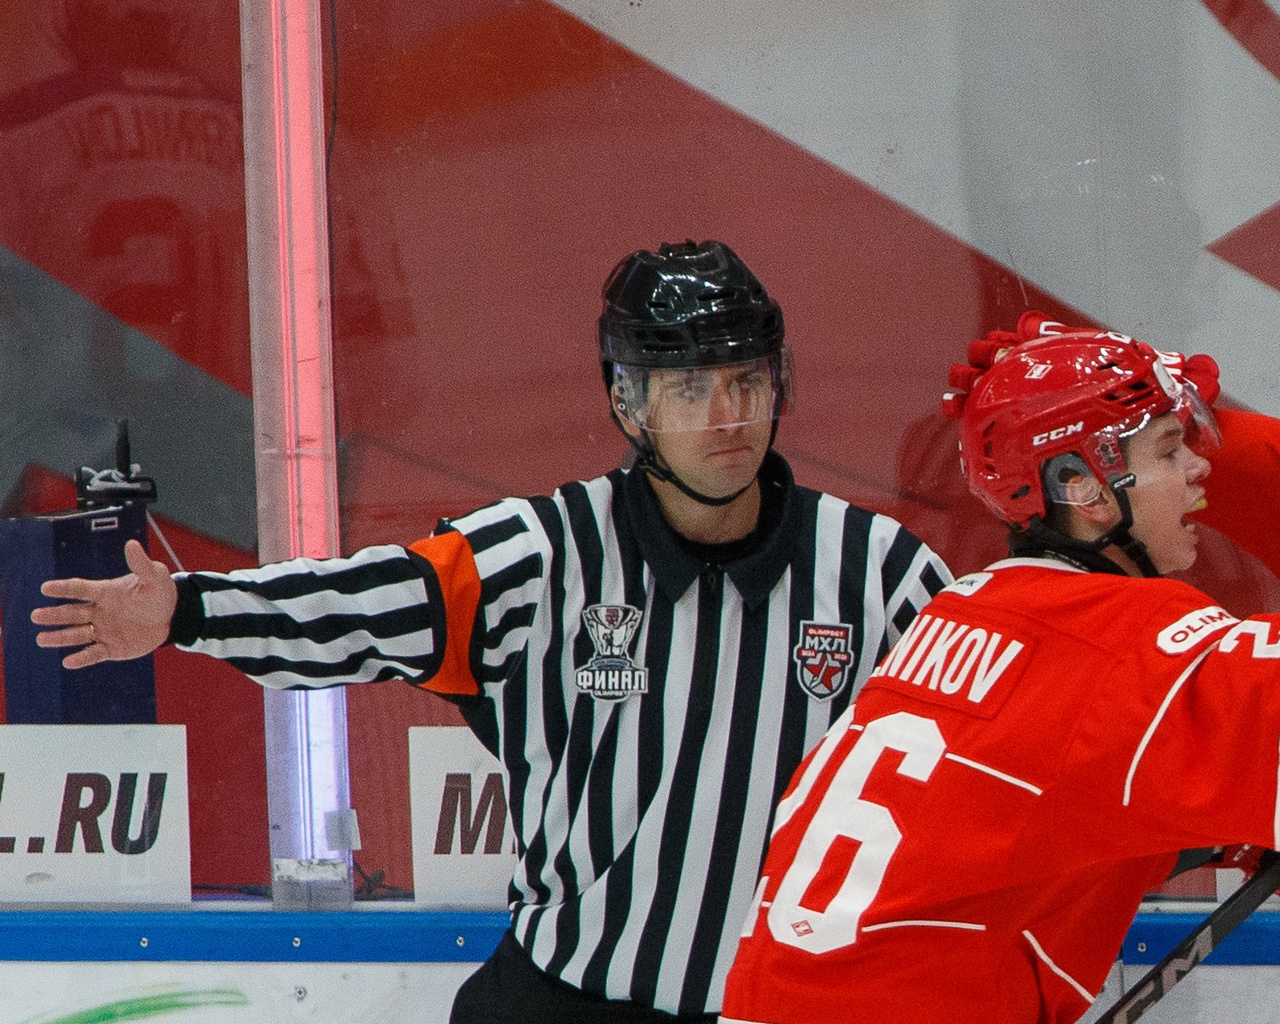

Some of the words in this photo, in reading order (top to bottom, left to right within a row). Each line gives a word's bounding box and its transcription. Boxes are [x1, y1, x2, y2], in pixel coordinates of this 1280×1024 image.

[1032, 421, 1084, 446] CCM
[1113, 475, 1135, 488] CCM
[805, 635, 846, 652] МХЛ
[870, 614, 1025, 704] NIKOV
[577, 669, 646, 690] ФИНАЛ
[433, 772, 516, 855] M
